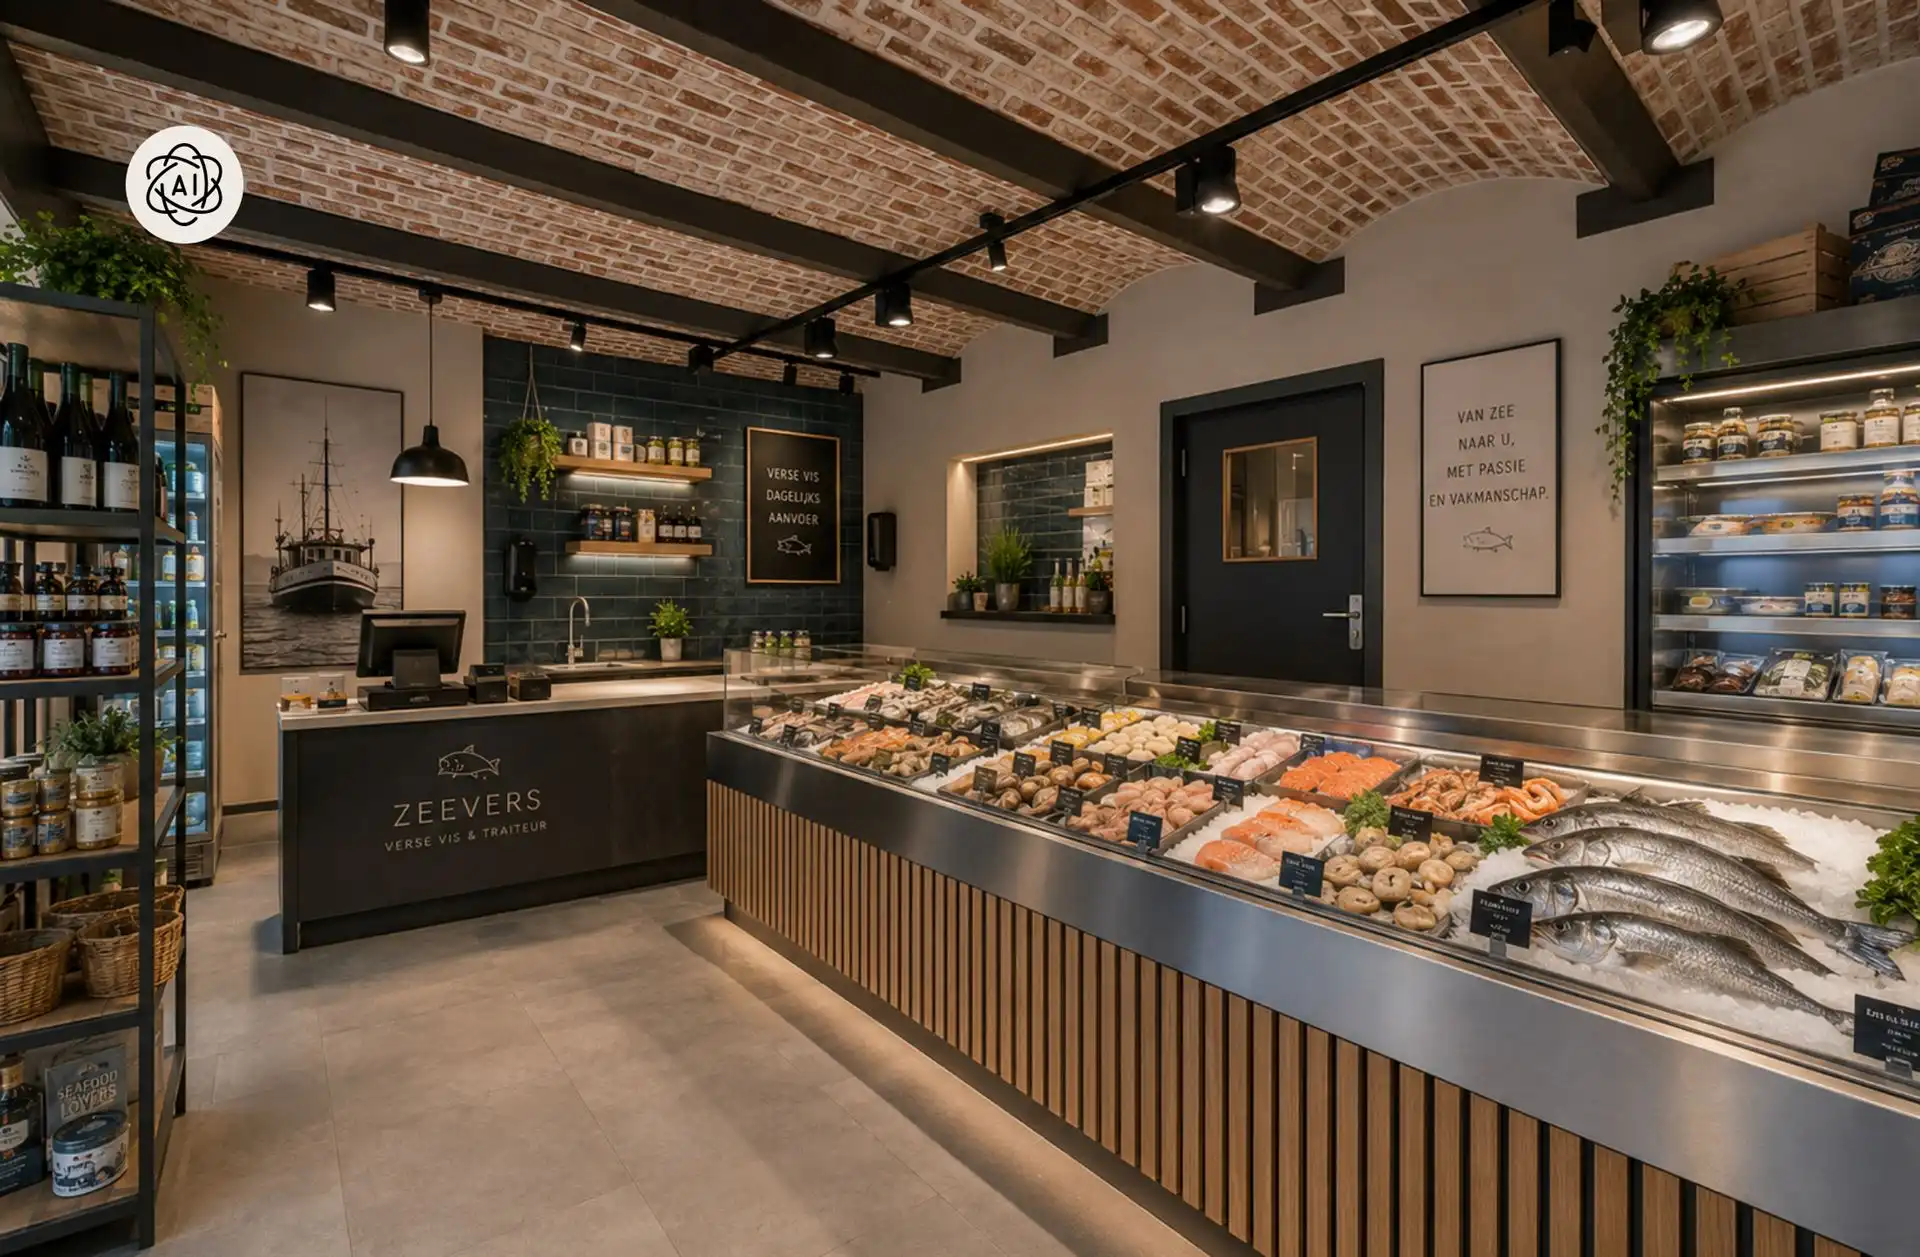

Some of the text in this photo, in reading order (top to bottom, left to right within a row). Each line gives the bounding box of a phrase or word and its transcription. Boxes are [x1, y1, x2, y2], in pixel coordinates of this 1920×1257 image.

[1457, 404, 1515, 425] VAN ZEE
[1458, 434, 1496, 451] NAAR
[766, 467, 820, 483] VERSE VIS
[1447, 458, 1526, 479] MET PASSIE
[766, 489, 821, 504] DAGELIJKS
[1429, 485, 1549, 508] EN VAKMANSCHAP.
[768, 511, 820, 526] AANVOER
[393, 788, 542, 828] ZEEVERS
[384, 820, 547, 852] VERSE VIS & TRAITEUR
[57, 1070, 118, 1100] SEAFOOD
